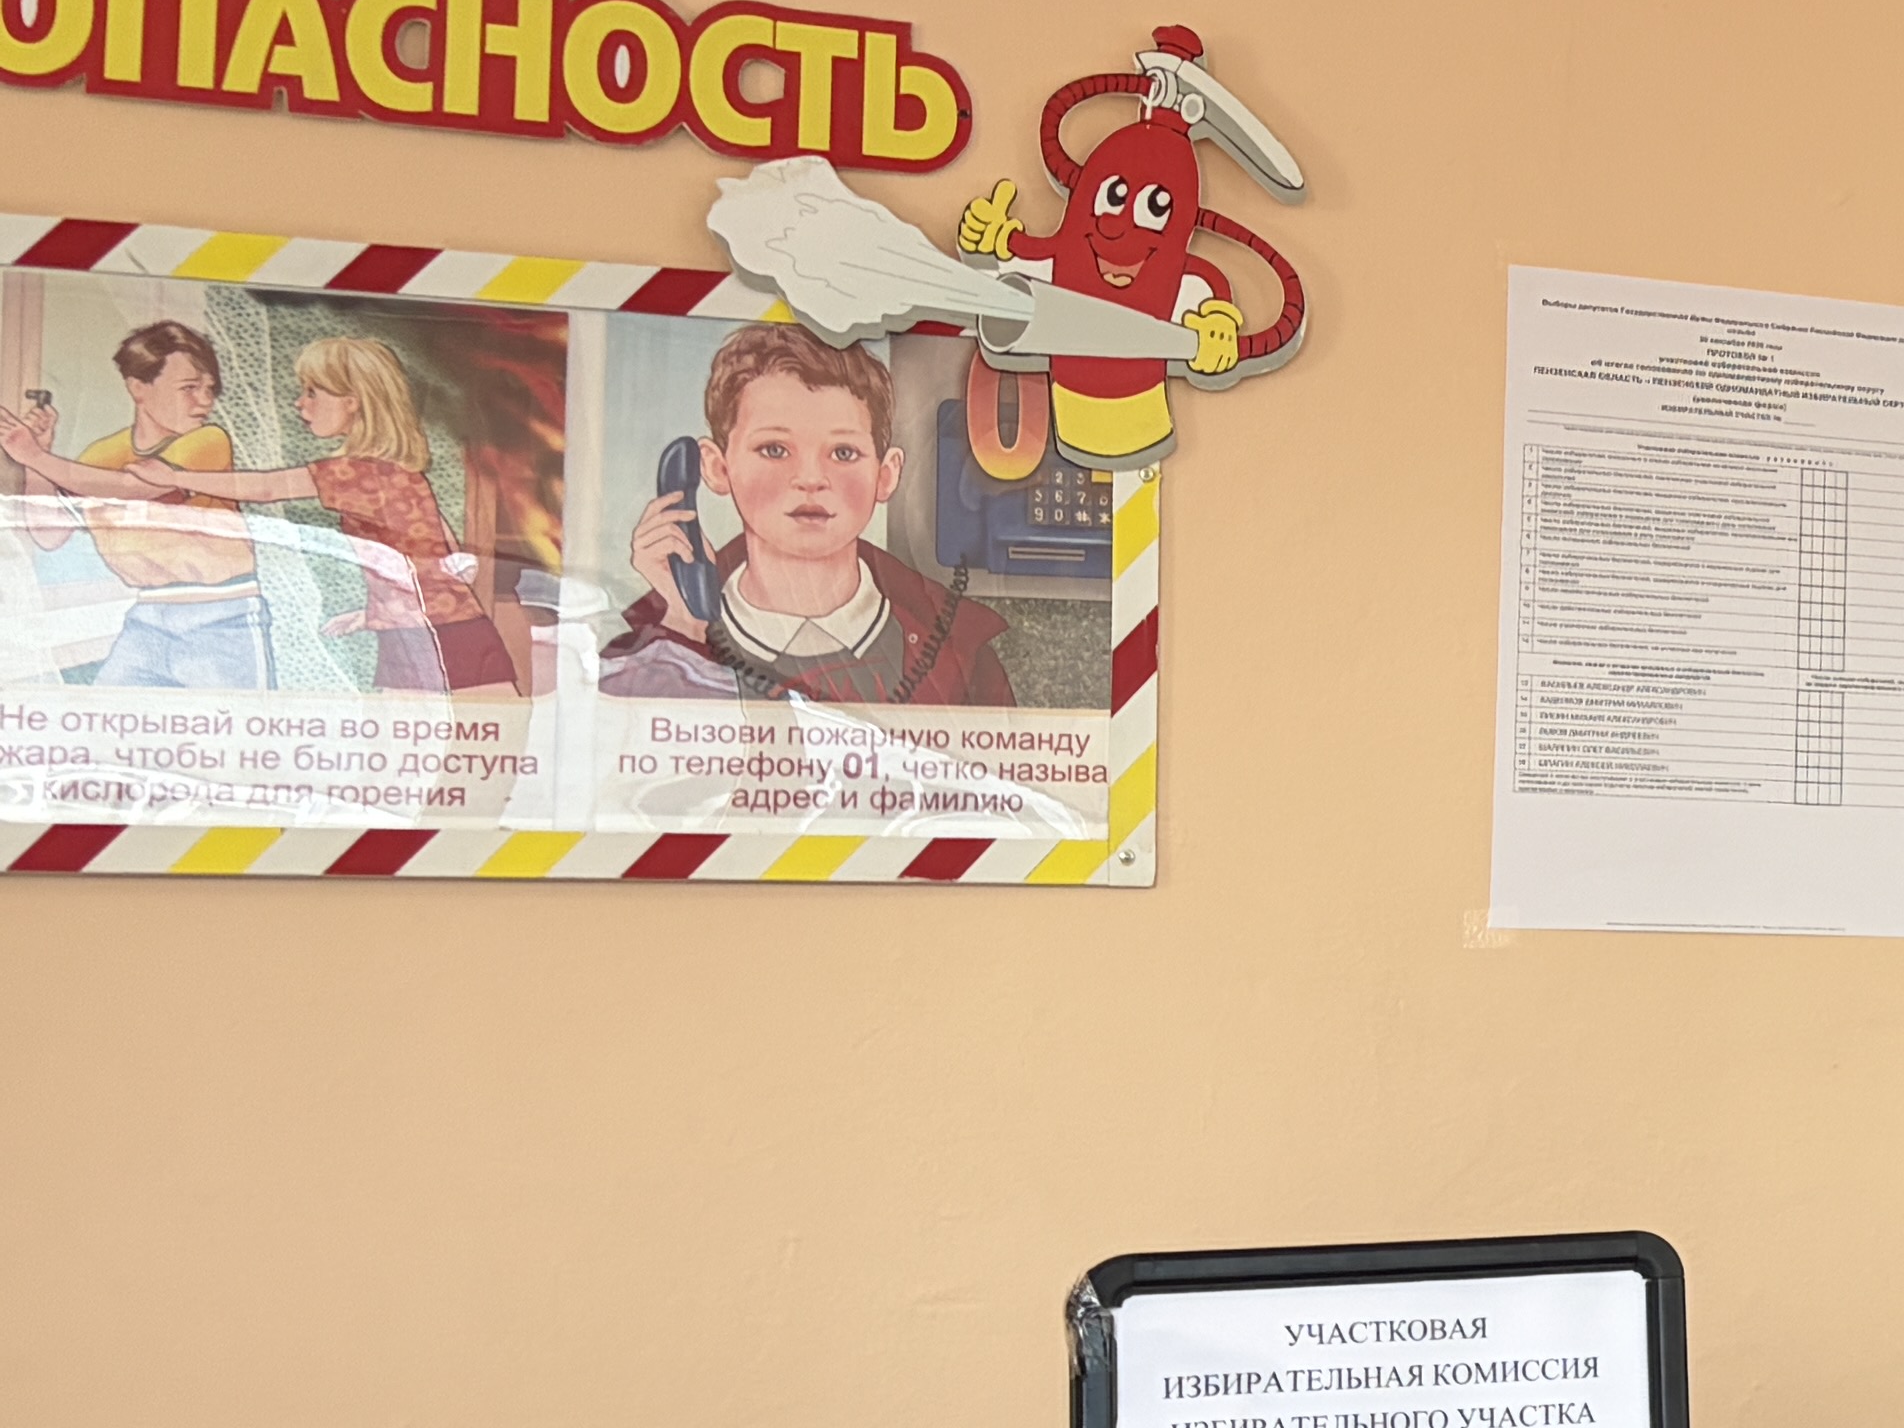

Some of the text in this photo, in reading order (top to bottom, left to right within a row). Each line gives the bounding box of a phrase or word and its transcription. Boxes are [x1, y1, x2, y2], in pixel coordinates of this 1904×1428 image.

[0, 703, 500, 748] Не открывай окна во время
[651, 716, 1091, 759] Вызови пожарную команду
[115, 741, 225, 770] чтобы
[239, 747, 281, 771] не
[294, 744, 388, 772] было
[398, 751, 539, 781] доступа
[619, 754, 658, 775] по
[670, 751, 833, 783] телефону
[842, 752, 890, 782] 01,
[903, 758, 988, 782] четко
[328, 783, 466, 811] горения
[731, 784, 1024, 816] адрес и фамилию
[1285, 1316, 1489, 1347] УЧАСТКОВАЯ
[1163, 1356, 1600, 1401] ИЗБИРАТЕЛЬНАЯ КОМИССИЯ
